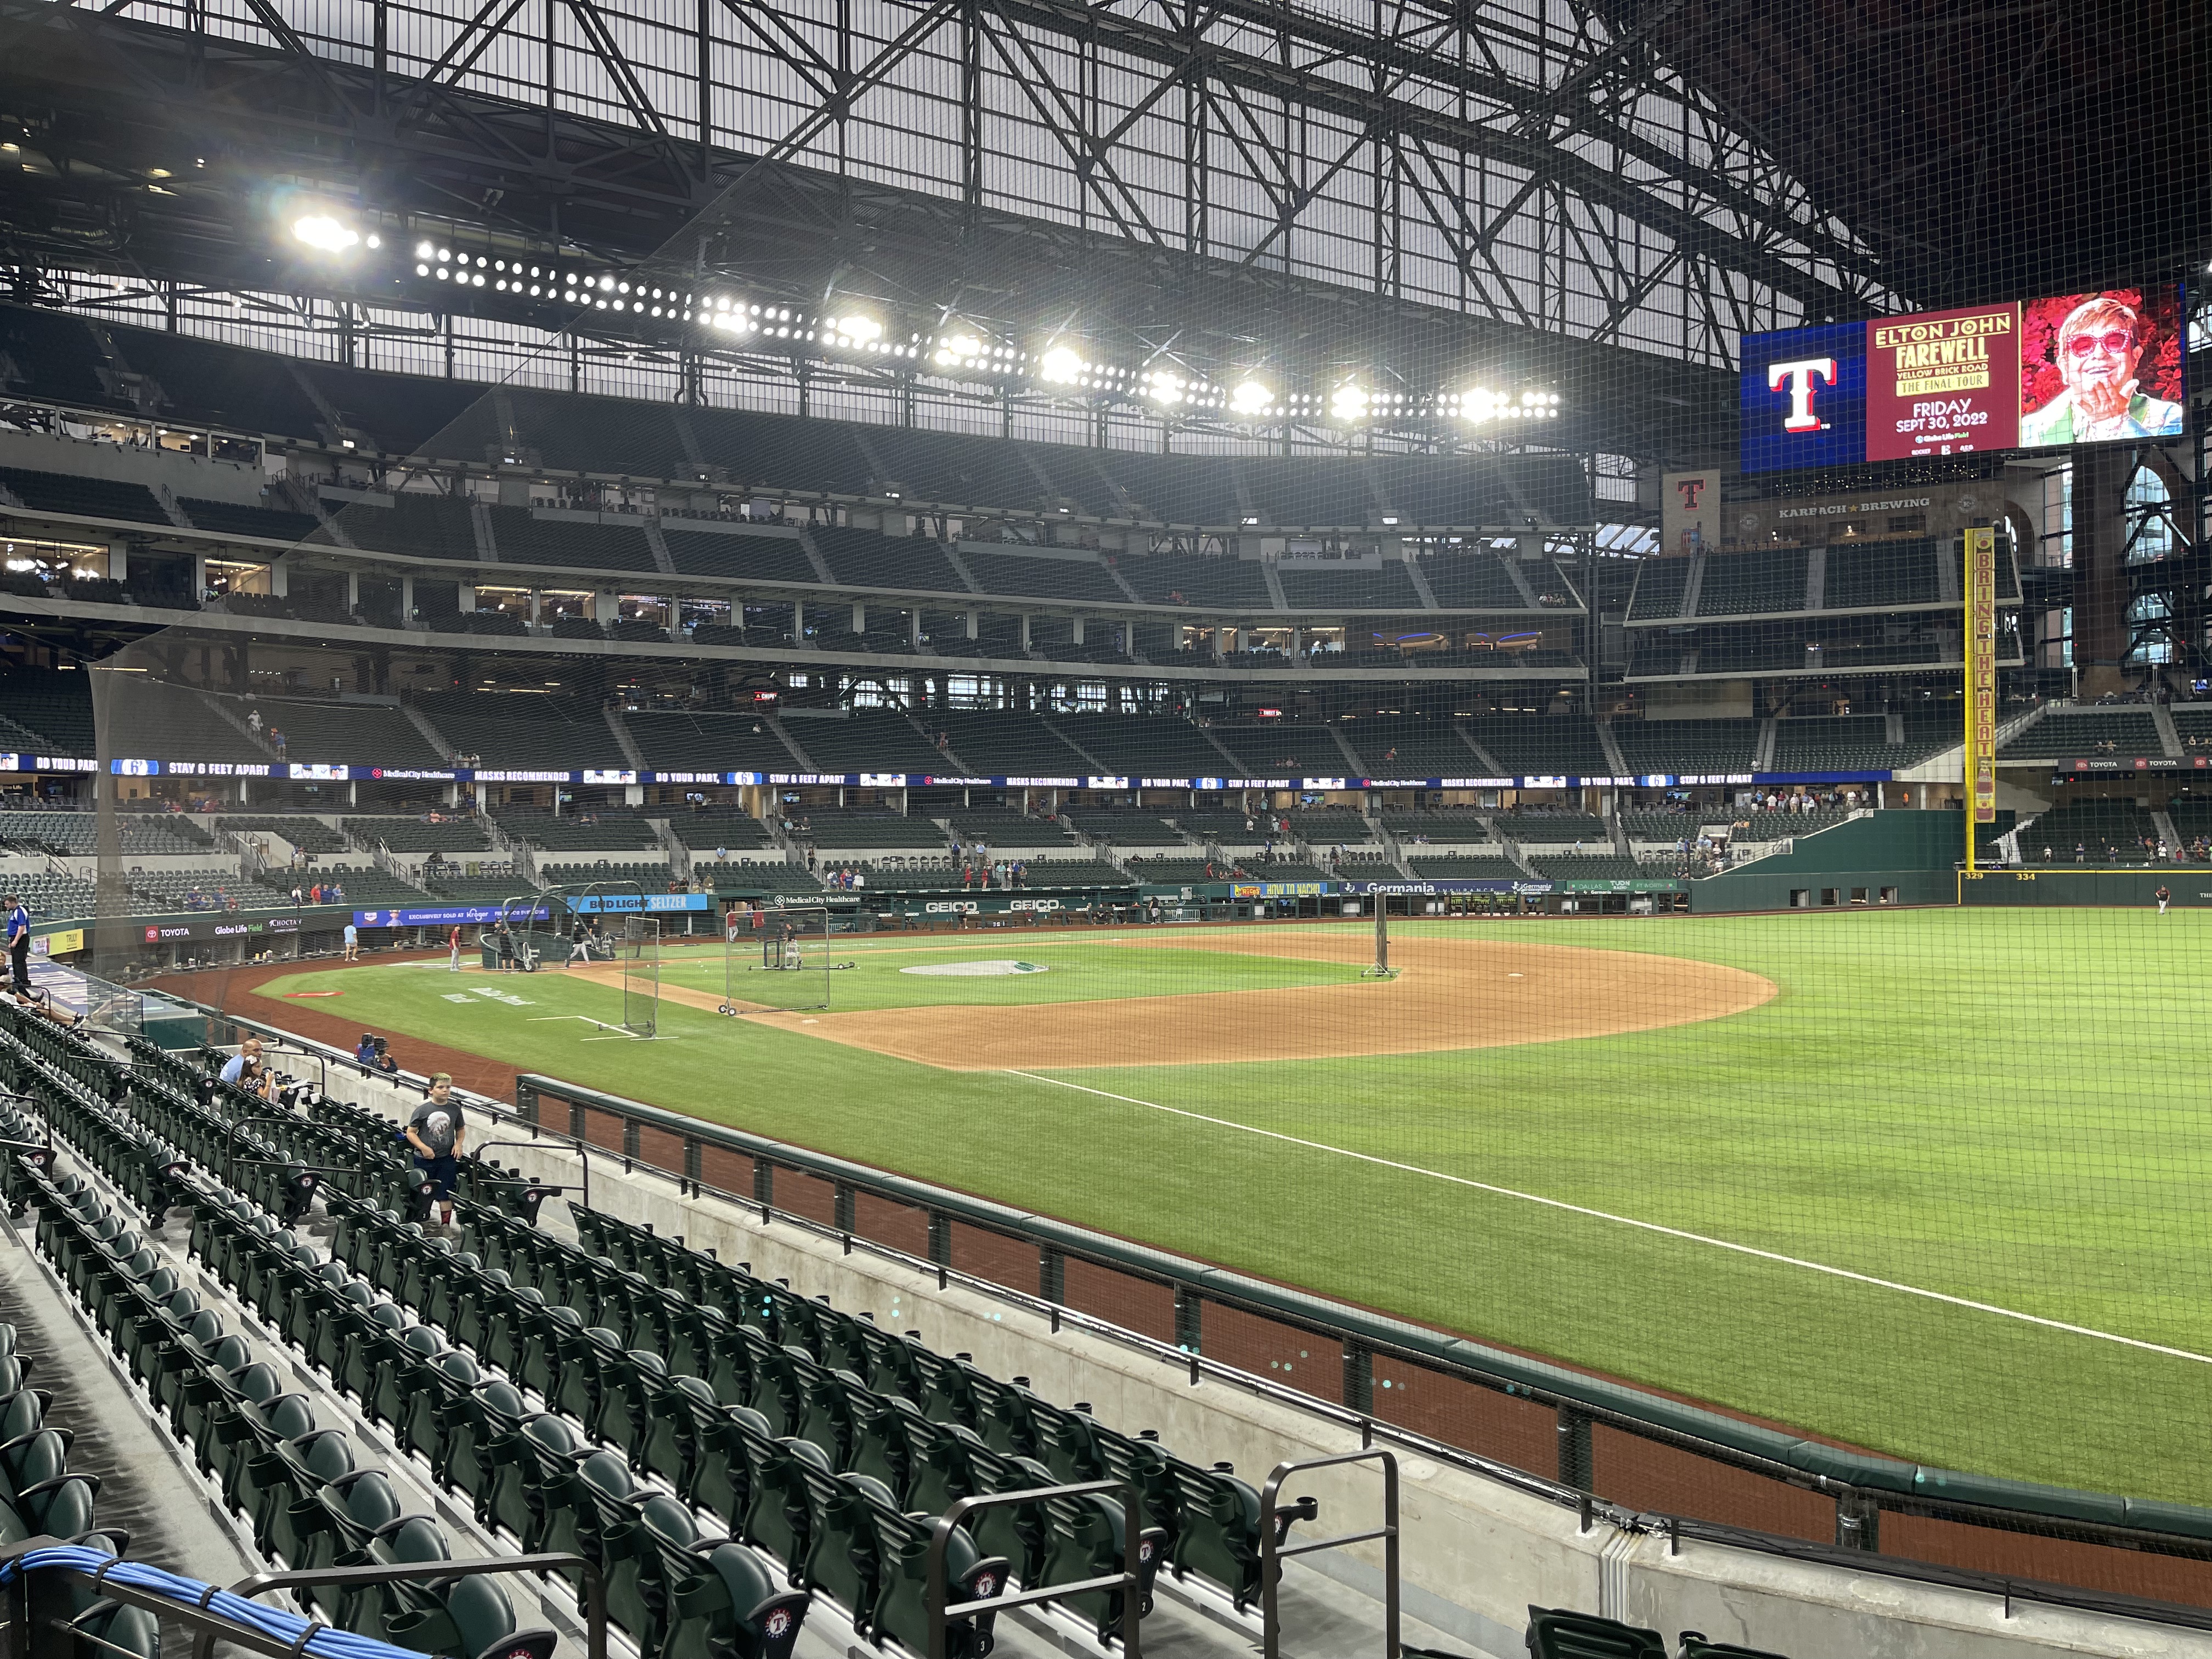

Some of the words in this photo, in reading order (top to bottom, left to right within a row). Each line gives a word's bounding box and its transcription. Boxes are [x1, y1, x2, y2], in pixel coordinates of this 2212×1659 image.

[1875, 323, 1943, 346] ELTON
[1950, 315, 2010, 337] JOHN
[1896, 336, 1989, 370] FAREWELL
[1897, 369, 1933, 380] YELLOW
[1934, 365, 1959, 376] BRICK
[1961, 363, 1988, 373] ROAD
[1902, 382, 1920, 393] THE
[1925, 379, 1951, 391] FINAL
[1957, 375, 1983, 387] TOUR
[1913, 398, 1972, 418] FRIDAY
[1896, 418, 1926, 432] SEPT
[1927, 416, 1950, 430] 30,
[1953, 411, 1988, 427] 2022
[1678, 479, 1705, 510] T
[1779, 505, 1846, 518] KARBACH
[1861, 498, 1929, 512] BREWING
[1979, 640, 1990, 685] THE
[1979, 693, 1990, 755] HEAT
[36, 757, 50, 769] DO
[52, 758, 75, 770] YOUR
[169, 762, 195, 774] STAY
[198, 763, 205, 774] 6
[208, 764, 233, 775] FEET
[235, 764, 269, 776] APART
[409, 771, 421, 780] City
[475, 771, 505, 781] MASKS
[506, 771, 569, 781] RECOMMENDED
[656, 773, 668, 782] DO
[670, 773, 693, 782] YOUR
[696, 774, 720, 784] PART,
[770, 774, 789, 783] STAY
[791, 775, 797, 783] 6
[799, 775, 817, 783] FEET
[819, 775, 845, 784] APART
[1006, 777, 1030, 786] MASKS
[1030, 778, 1078, 786] RECOMMENDED
[1592, 777, 1611, 785] YOUR
[1614, 776, 1635, 786] PART,
[1680, 775, 1699, 785] STAY
[1707, 775, 1725, 783] FEET
[1726, 774, 1752, 783] APART
[1142, 778, 1151, 787] DO
[1153, 778, 1170, 787] YOUR
[1172, 778, 1190, 788] PART,
[1228, 779, 1244, 788] STAY
[1251, 780, 1266, 788] FEET
[1267, 780, 1290, 788] APART
[1441, 778, 1464, 787] MASKS
[1465, 778, 1514, 787] RECOMMENDED
[1267, 884, 1284, 895] HOW
[1286, 883, 1295, 894] TO
[1296, 883, 1320, 894] NACHO
[1367, 882, 1435, 893] Germania
[651, 896, 686, 910] SELTZER
[811, 896, 825, 905] City
[1010, 899, 1059, 911] GEICO
[926, 901, 978, 913] GEICO
[466, 909, 488, 921] Kroger
[161, 928, 189, 937] TOYOTA
[215, 926, 235, 935] Globe
[235, 924, 247, 933] Life
[248, 923, 262, 932] Field
[66, 933, 77, 943] TRULY
[1142, 1601, 1146, 1612] 2
[980, 1640, 985, 1652] 3
